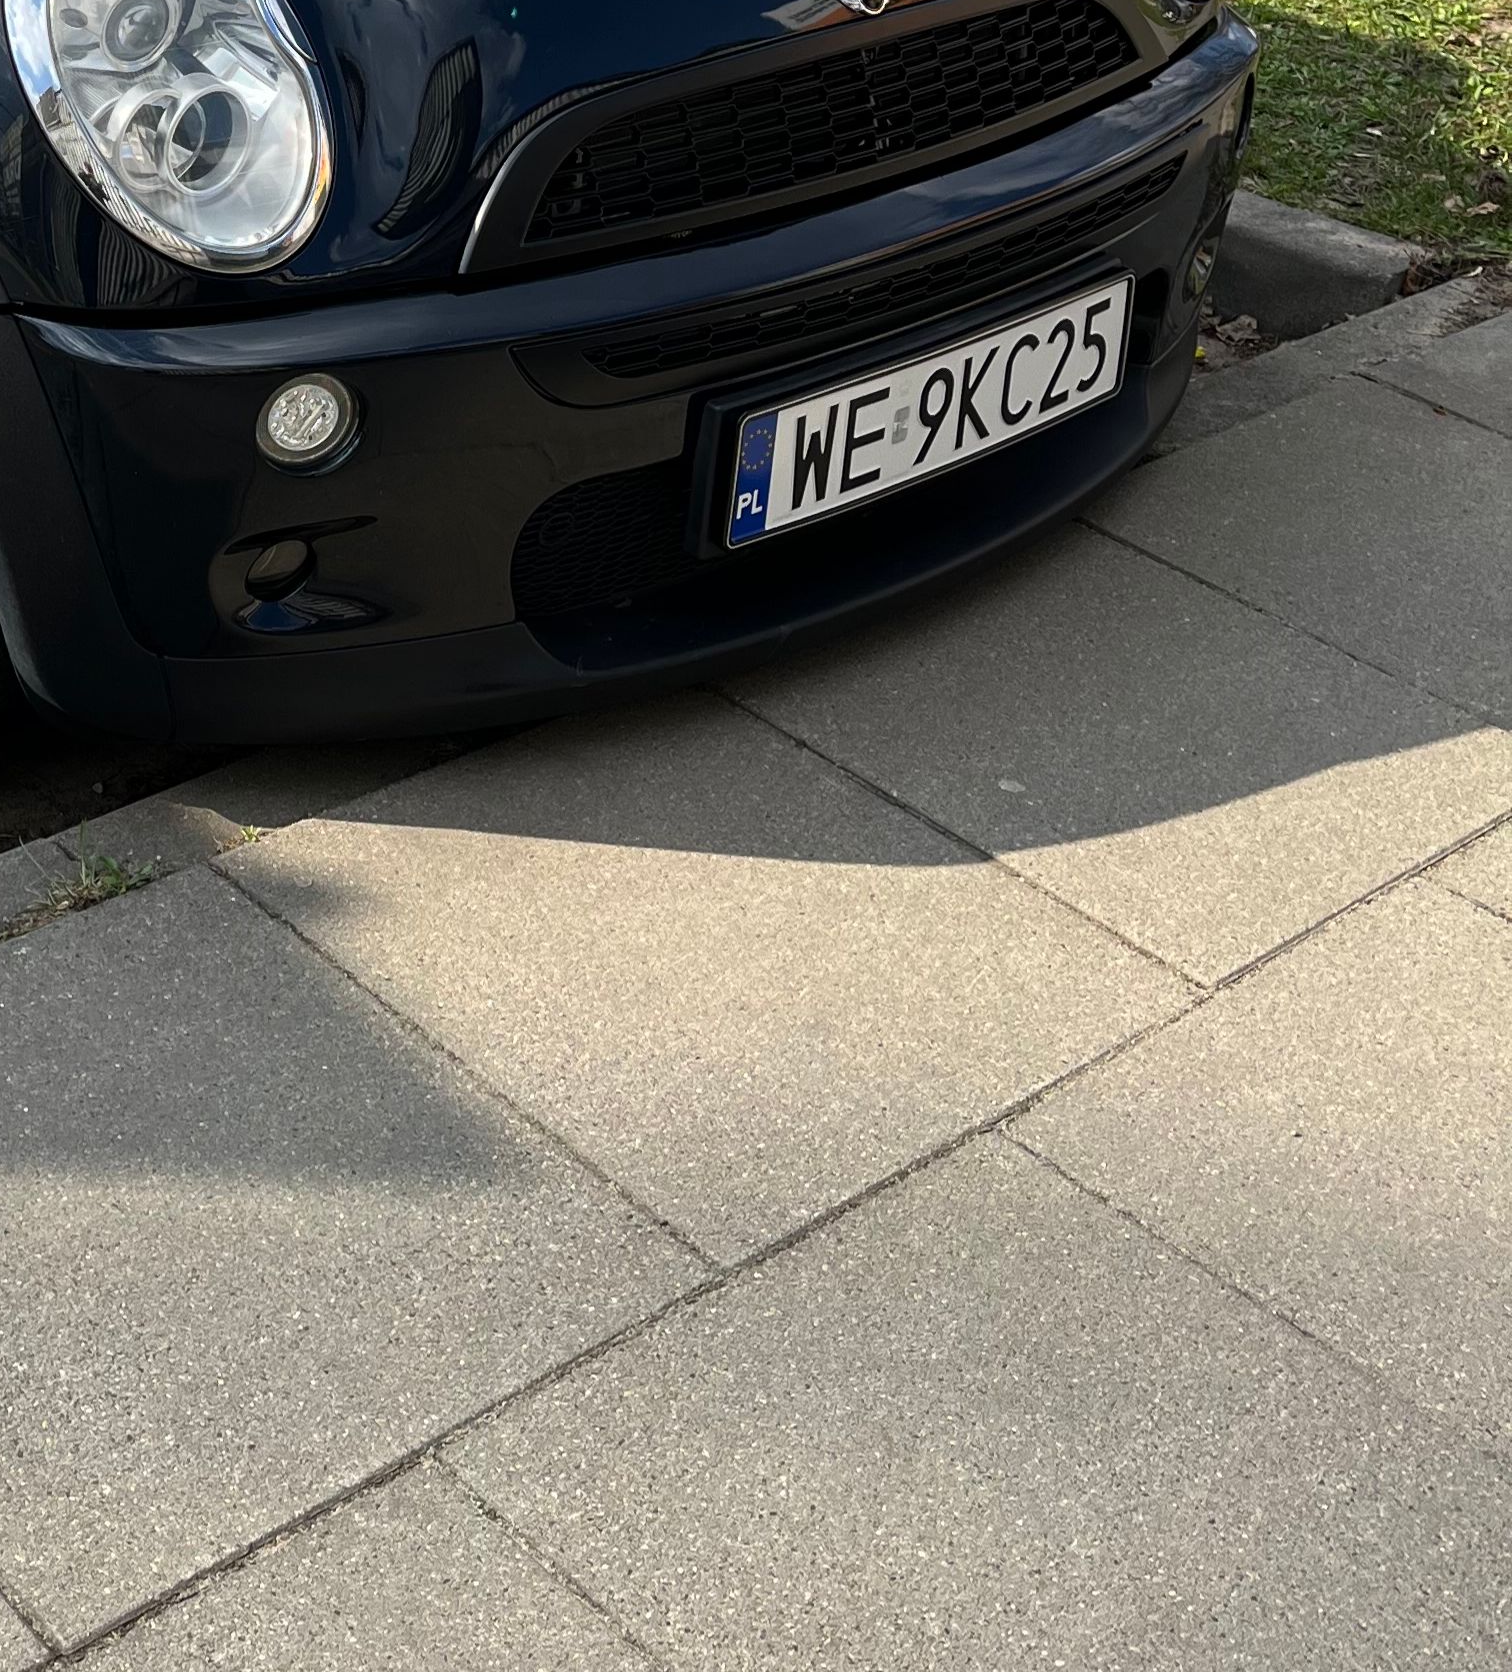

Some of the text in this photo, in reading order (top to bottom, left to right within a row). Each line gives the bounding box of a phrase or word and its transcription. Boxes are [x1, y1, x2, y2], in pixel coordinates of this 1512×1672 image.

[791, 297, 1113, 511] WE 9KC25
[735, 488, 763, 520] PL
